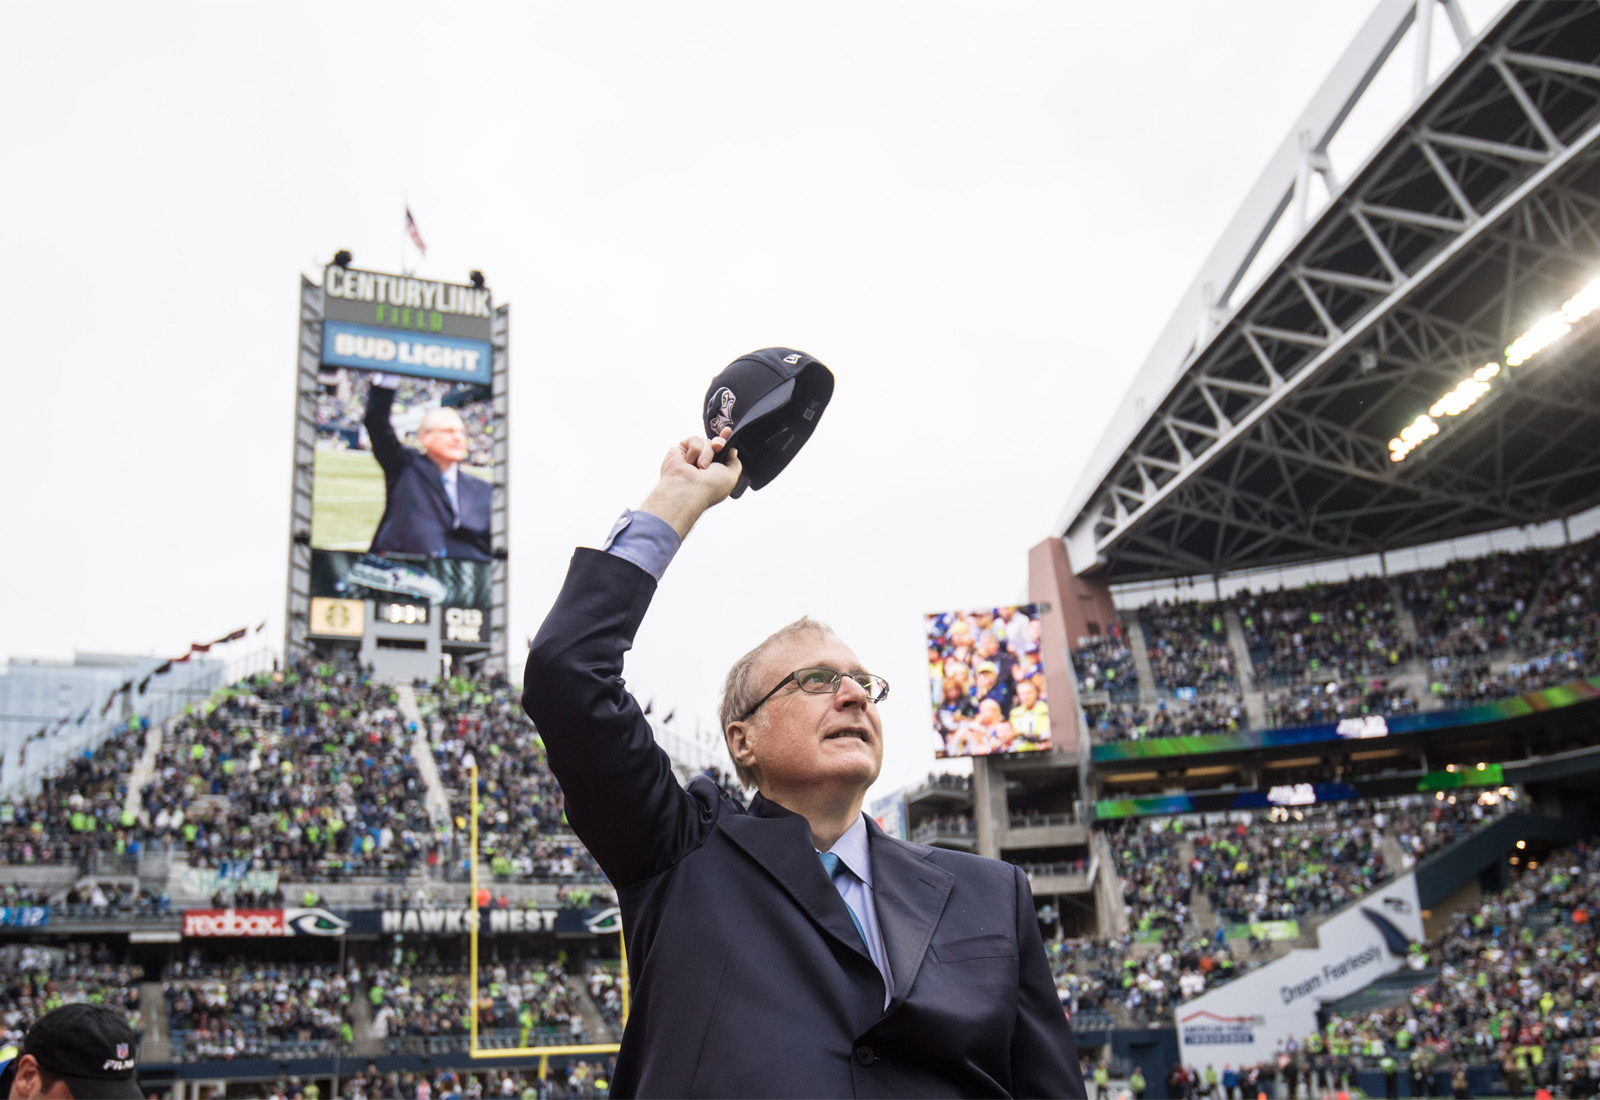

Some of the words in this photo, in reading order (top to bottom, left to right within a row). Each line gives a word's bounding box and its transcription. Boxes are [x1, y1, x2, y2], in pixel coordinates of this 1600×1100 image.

[325, 264, 491, 318] CENTURYLINK
[376, 304, 443, 332] FIELD
[334, 332, 396, 362] BUD
[399, 341, 480, 372] LIGHT
[381, 910, 480, 933] HAWKS
[489, 909, 558, 932] NEST
[1280, 973, 1322, 1005] Dream
[1322, 944, 1383, 982] Fearlessly
